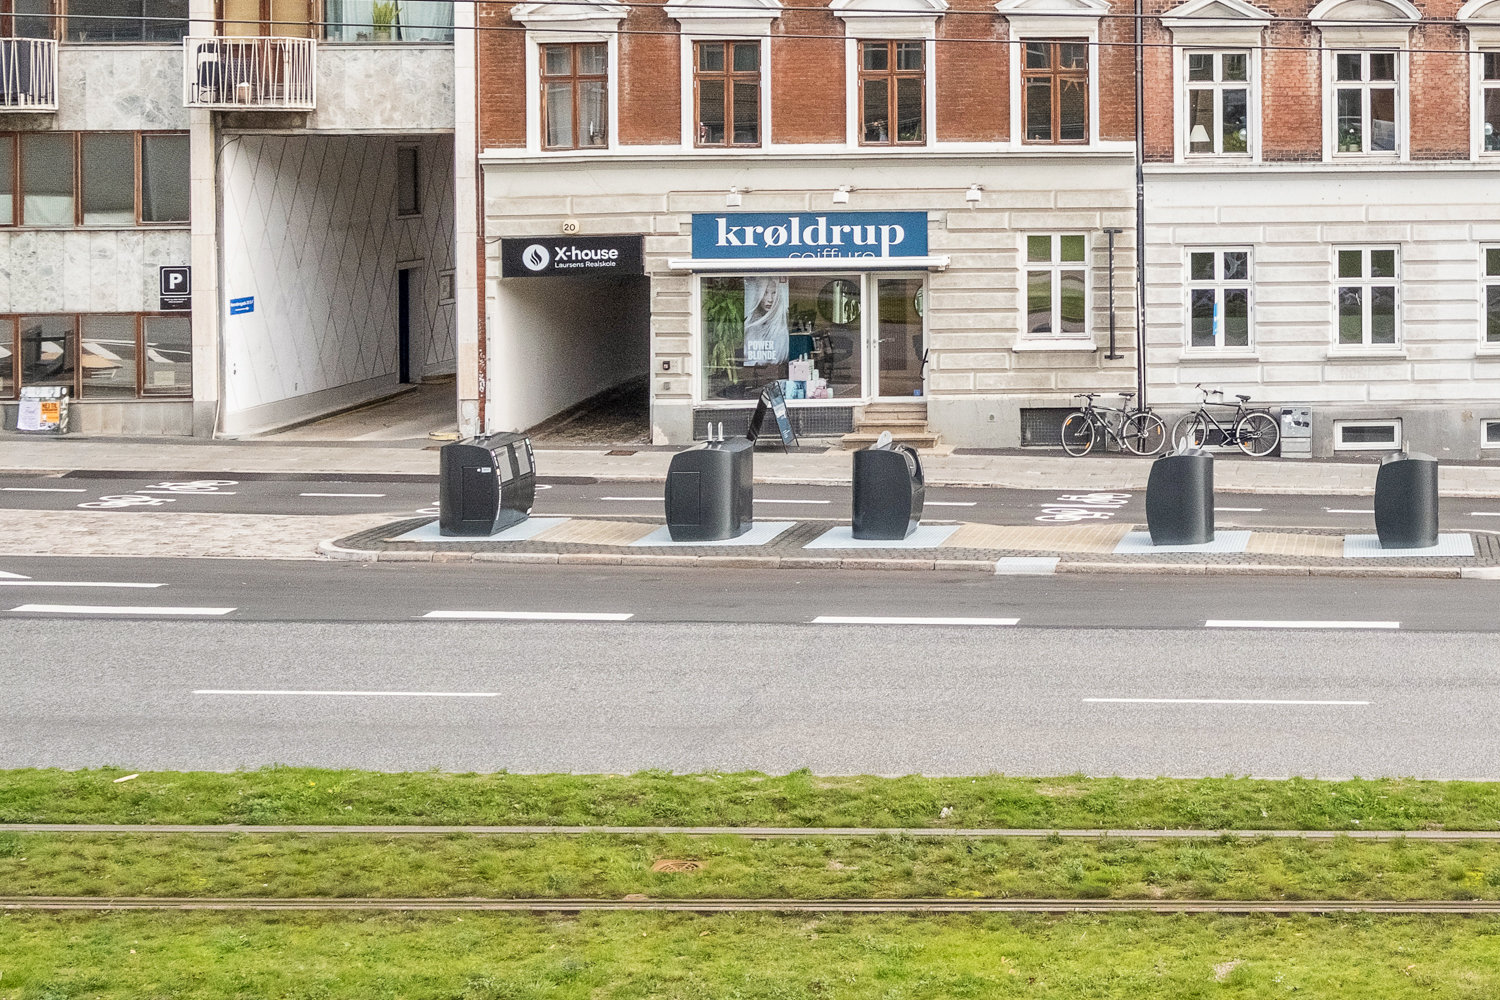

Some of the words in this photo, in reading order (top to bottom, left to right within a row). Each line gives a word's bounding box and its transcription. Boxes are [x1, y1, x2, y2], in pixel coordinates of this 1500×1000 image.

[563, 223, 576, 232] 20
[714, 216, 905, 258] krøldrup
[554, 246, 618, 260] X-house
[585, 260, 616, 268] Realskole
[169, 273, 183, 290] P
[748, 340, 774, 350] POWER
[748, 350, 776, 360] BLONDE
